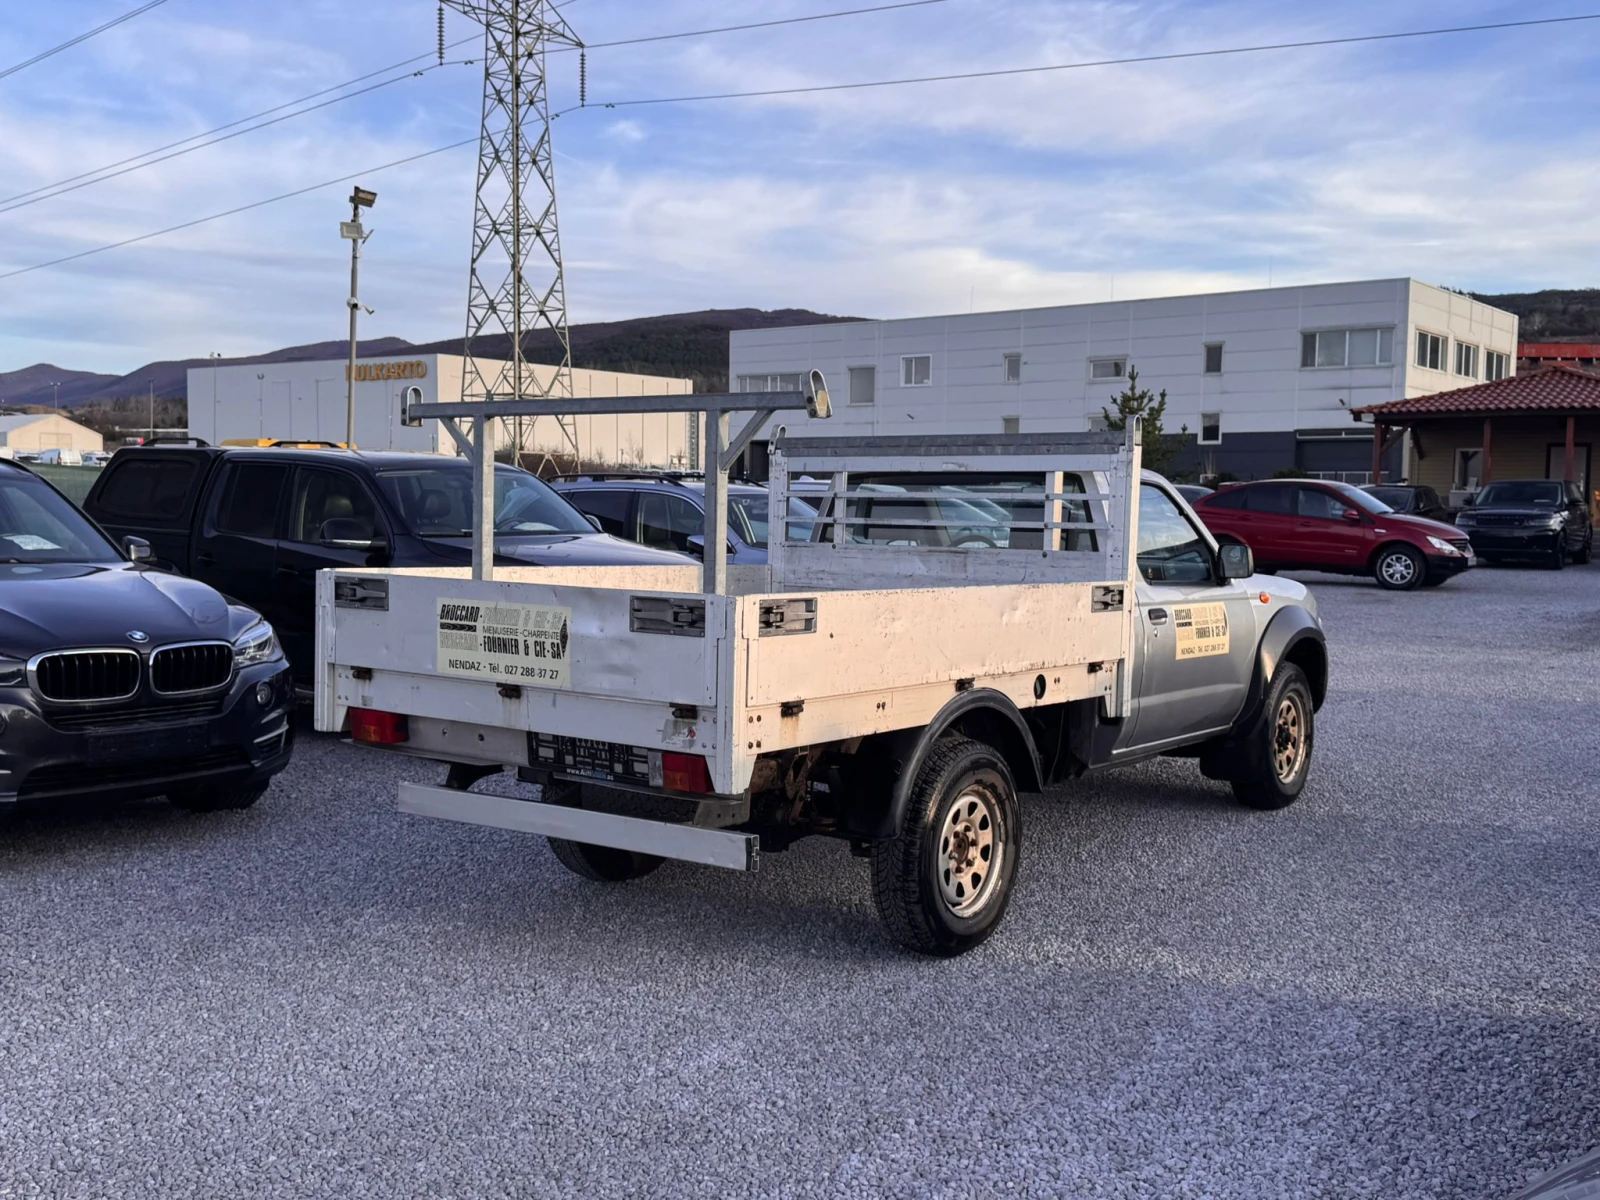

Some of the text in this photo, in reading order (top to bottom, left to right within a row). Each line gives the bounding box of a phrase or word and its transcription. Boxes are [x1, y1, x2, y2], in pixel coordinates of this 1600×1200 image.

[345, 360, 427, 381] ULKARTO
[439, 603, 480, 622] BROCCARD
[483, 635, 519, 656] FOURNIER
[523, 639, 530, 657] &
[448, 659, 481, 671] NENDAZ
[504, 664, 518, 675] 027
[520, 666, 535, 678] 288
[549, 669, 559, 680] 27
